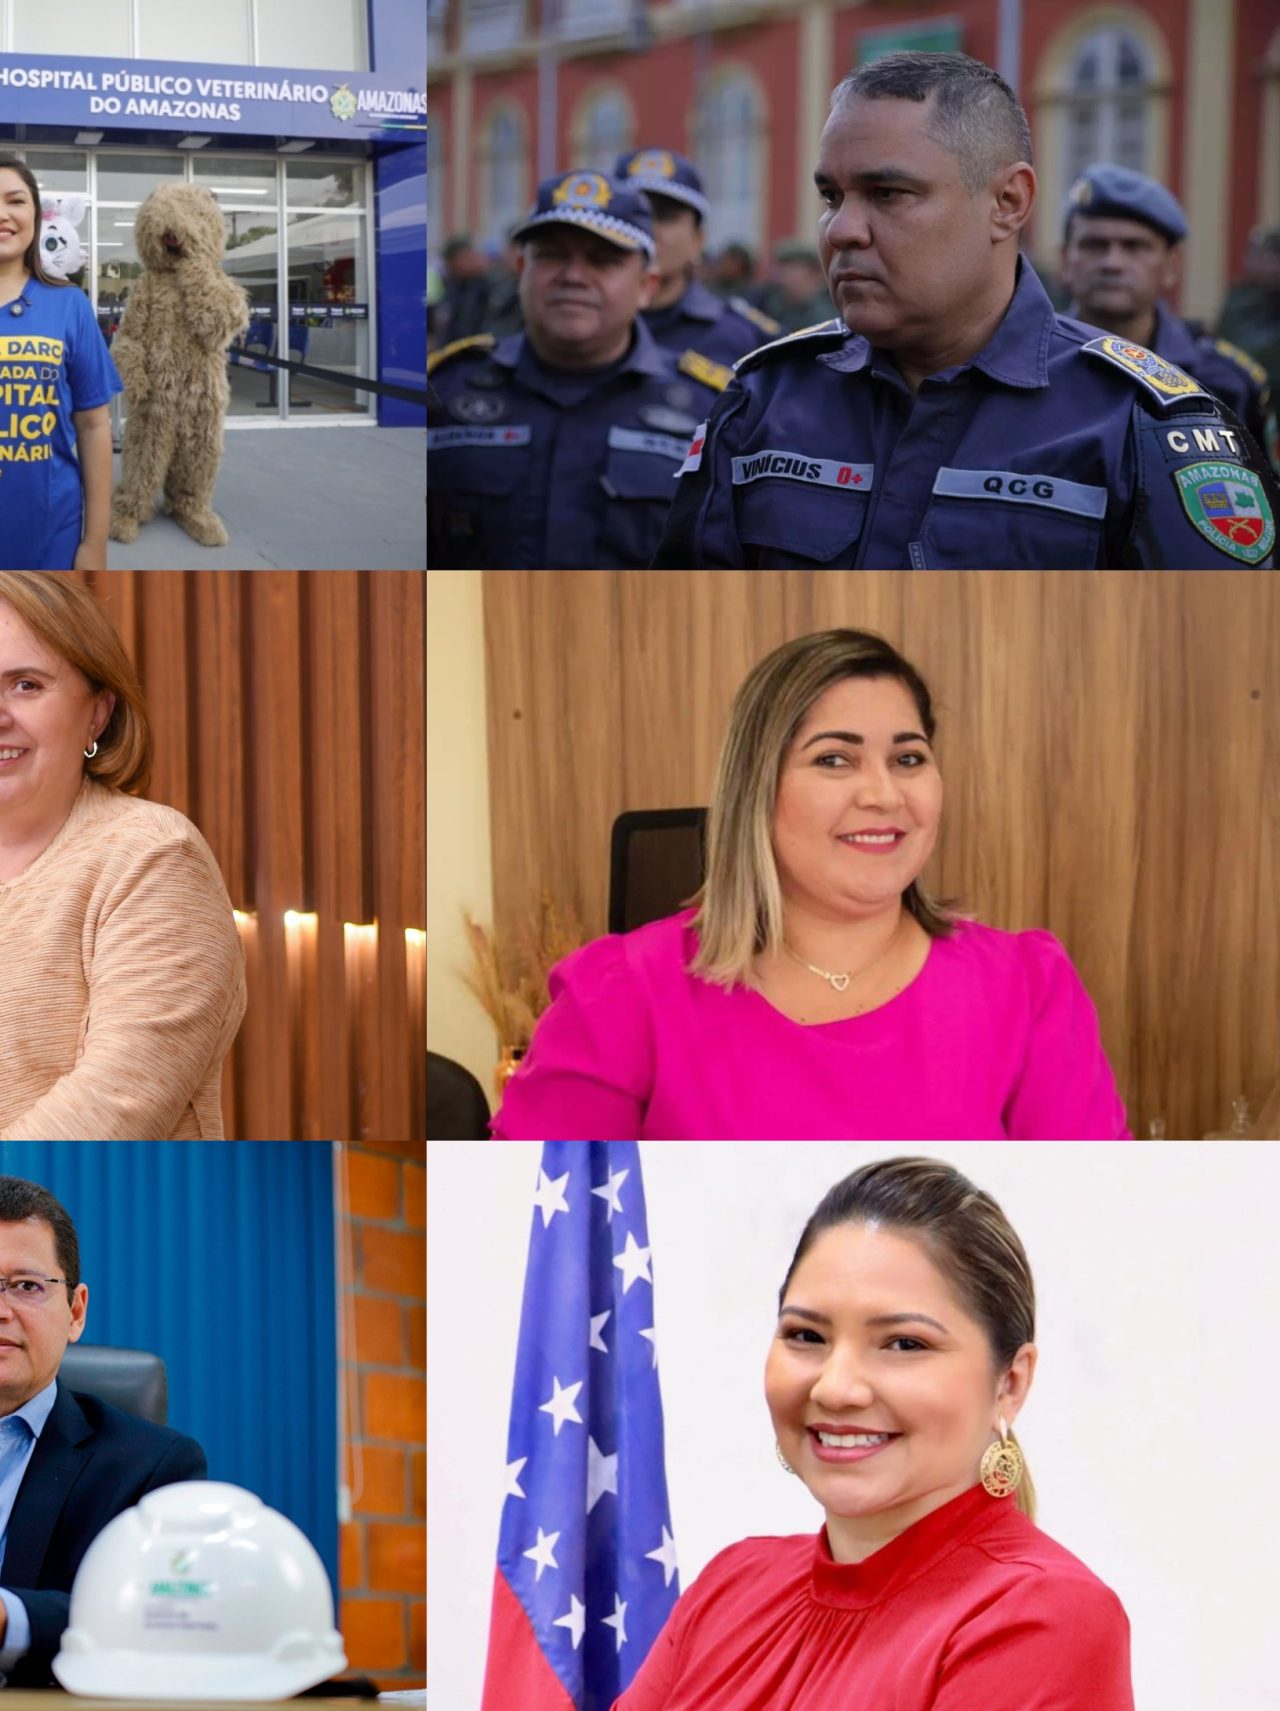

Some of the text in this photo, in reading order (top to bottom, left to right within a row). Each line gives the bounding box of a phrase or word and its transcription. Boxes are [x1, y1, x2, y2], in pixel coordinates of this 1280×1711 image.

[102, 70, 192, 96] PÚBLICO
[196, 79, 328, 104] VETERINÁRIO
[89, 96, 241, 121] DO AMAZONAS
[357, 89, 427, 114] AMAZONAS
[1166, 429, 1236, 453] CMT
[742, 454, 823, 480] VINÍCIUS
[1179, 466, 1259, 489] AMAZONAS
[982, 476, 1055, 500] QCG
